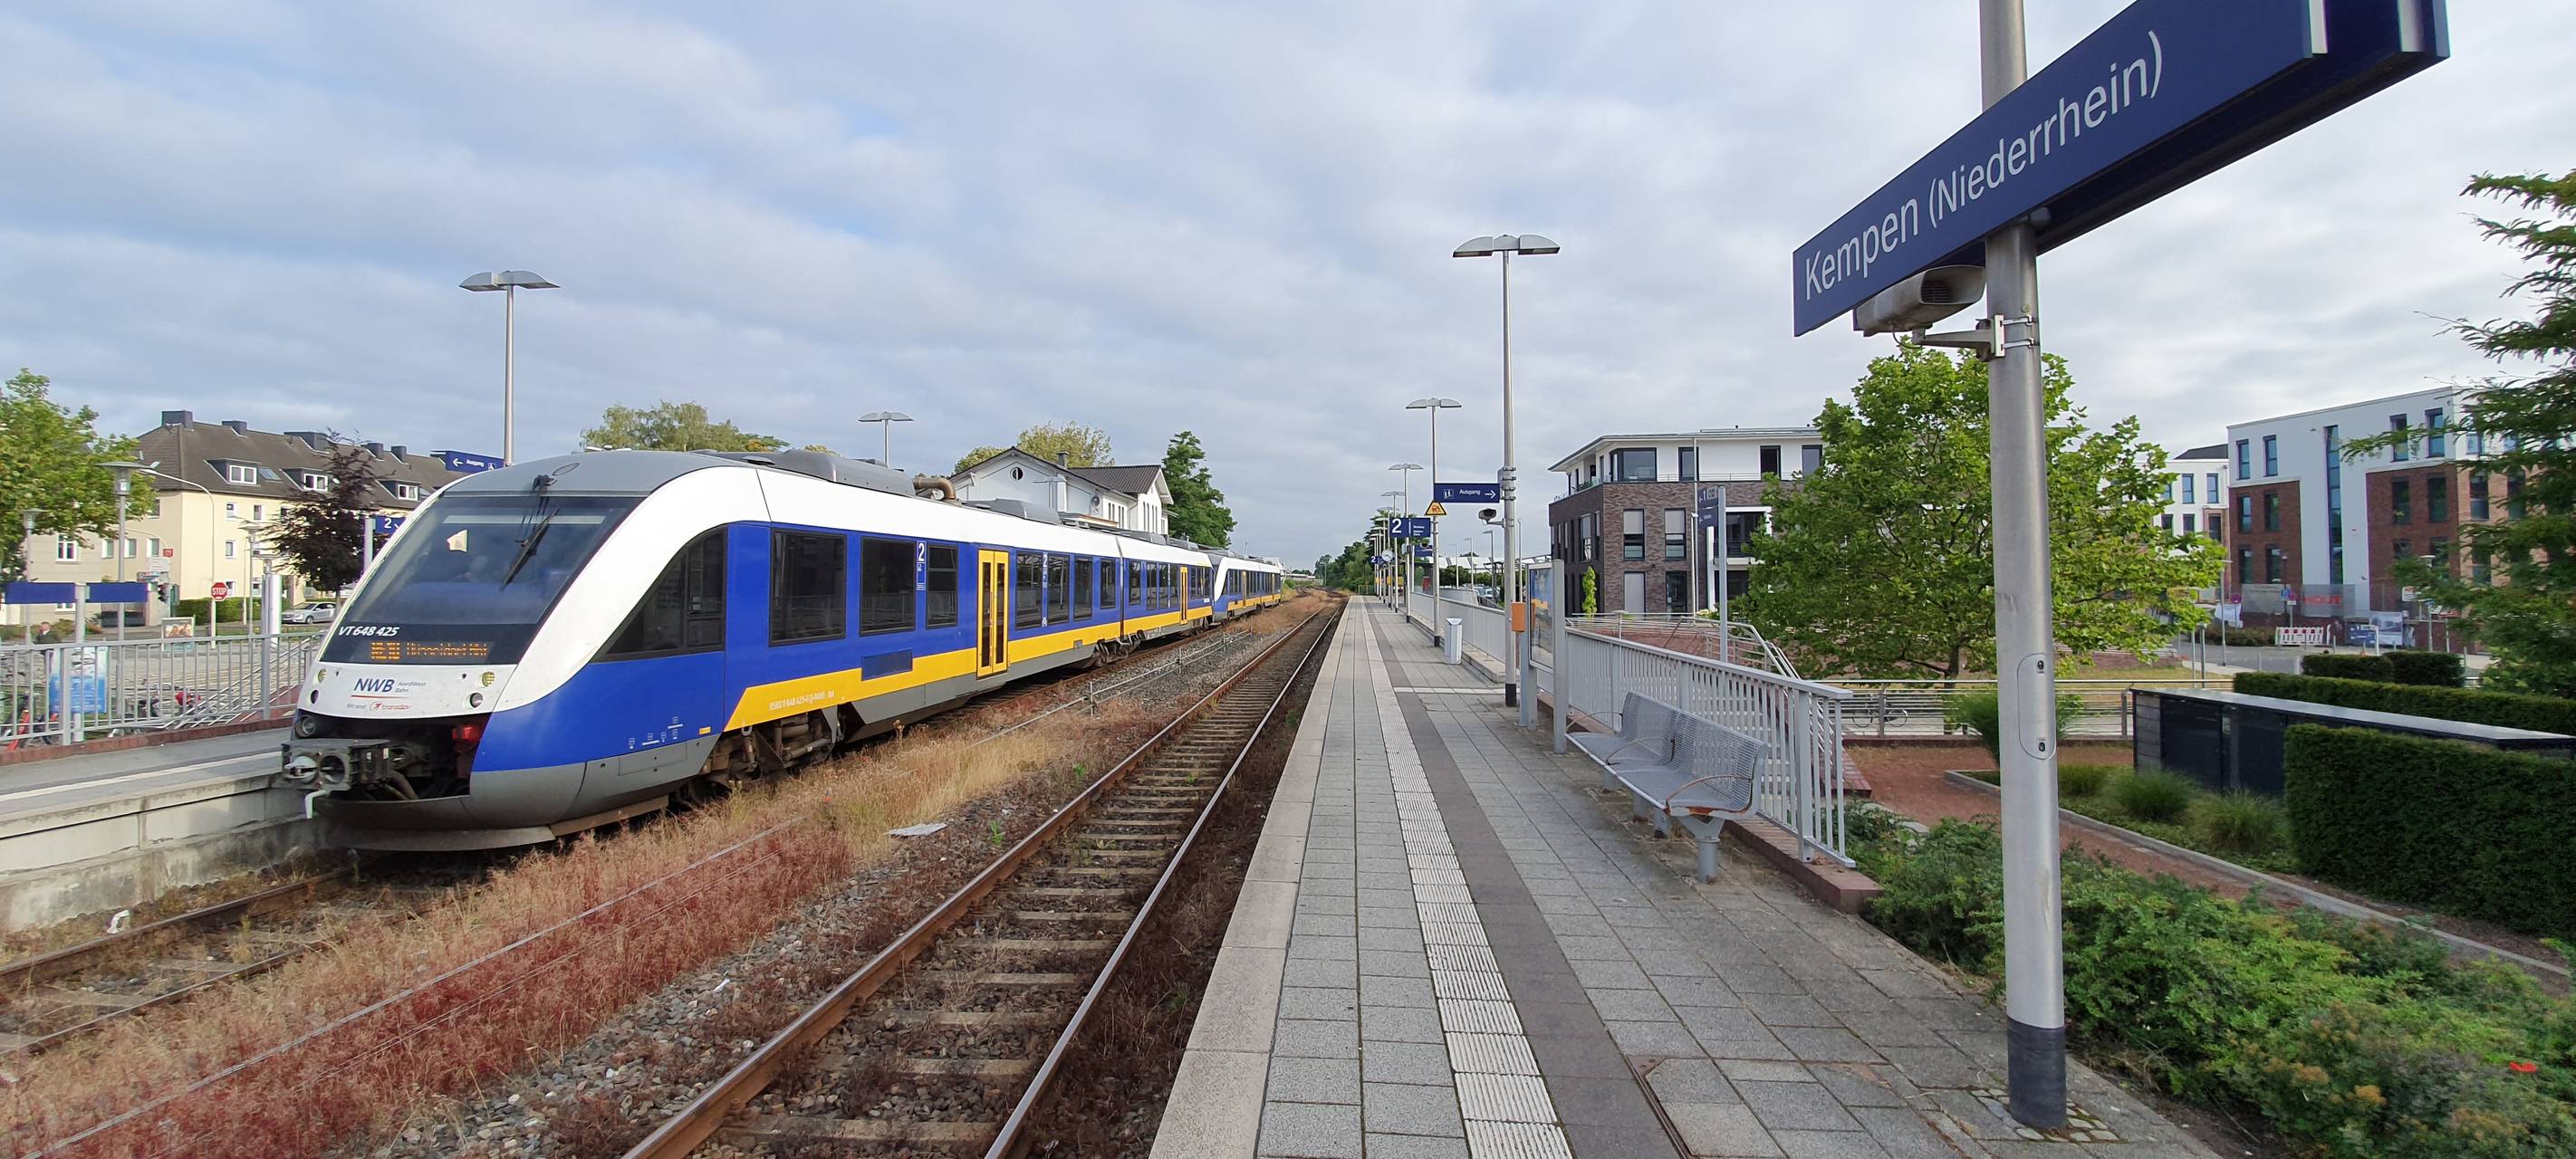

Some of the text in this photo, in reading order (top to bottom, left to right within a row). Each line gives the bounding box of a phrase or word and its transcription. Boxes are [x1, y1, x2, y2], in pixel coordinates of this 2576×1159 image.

[1805, 30, 2162, 301] Kempen (Niederrhein)
[384, 518, 392, 529] 2
[1391, 518, 1402, 533] 2
[918, 542, 925, 562] 2
[1370, 555, 1376, 563] 2
[1043, 554, 1048, 568] 2
[339, 626, 399, 637] VT 648 425
[353, 677, 395, 693] NWB
